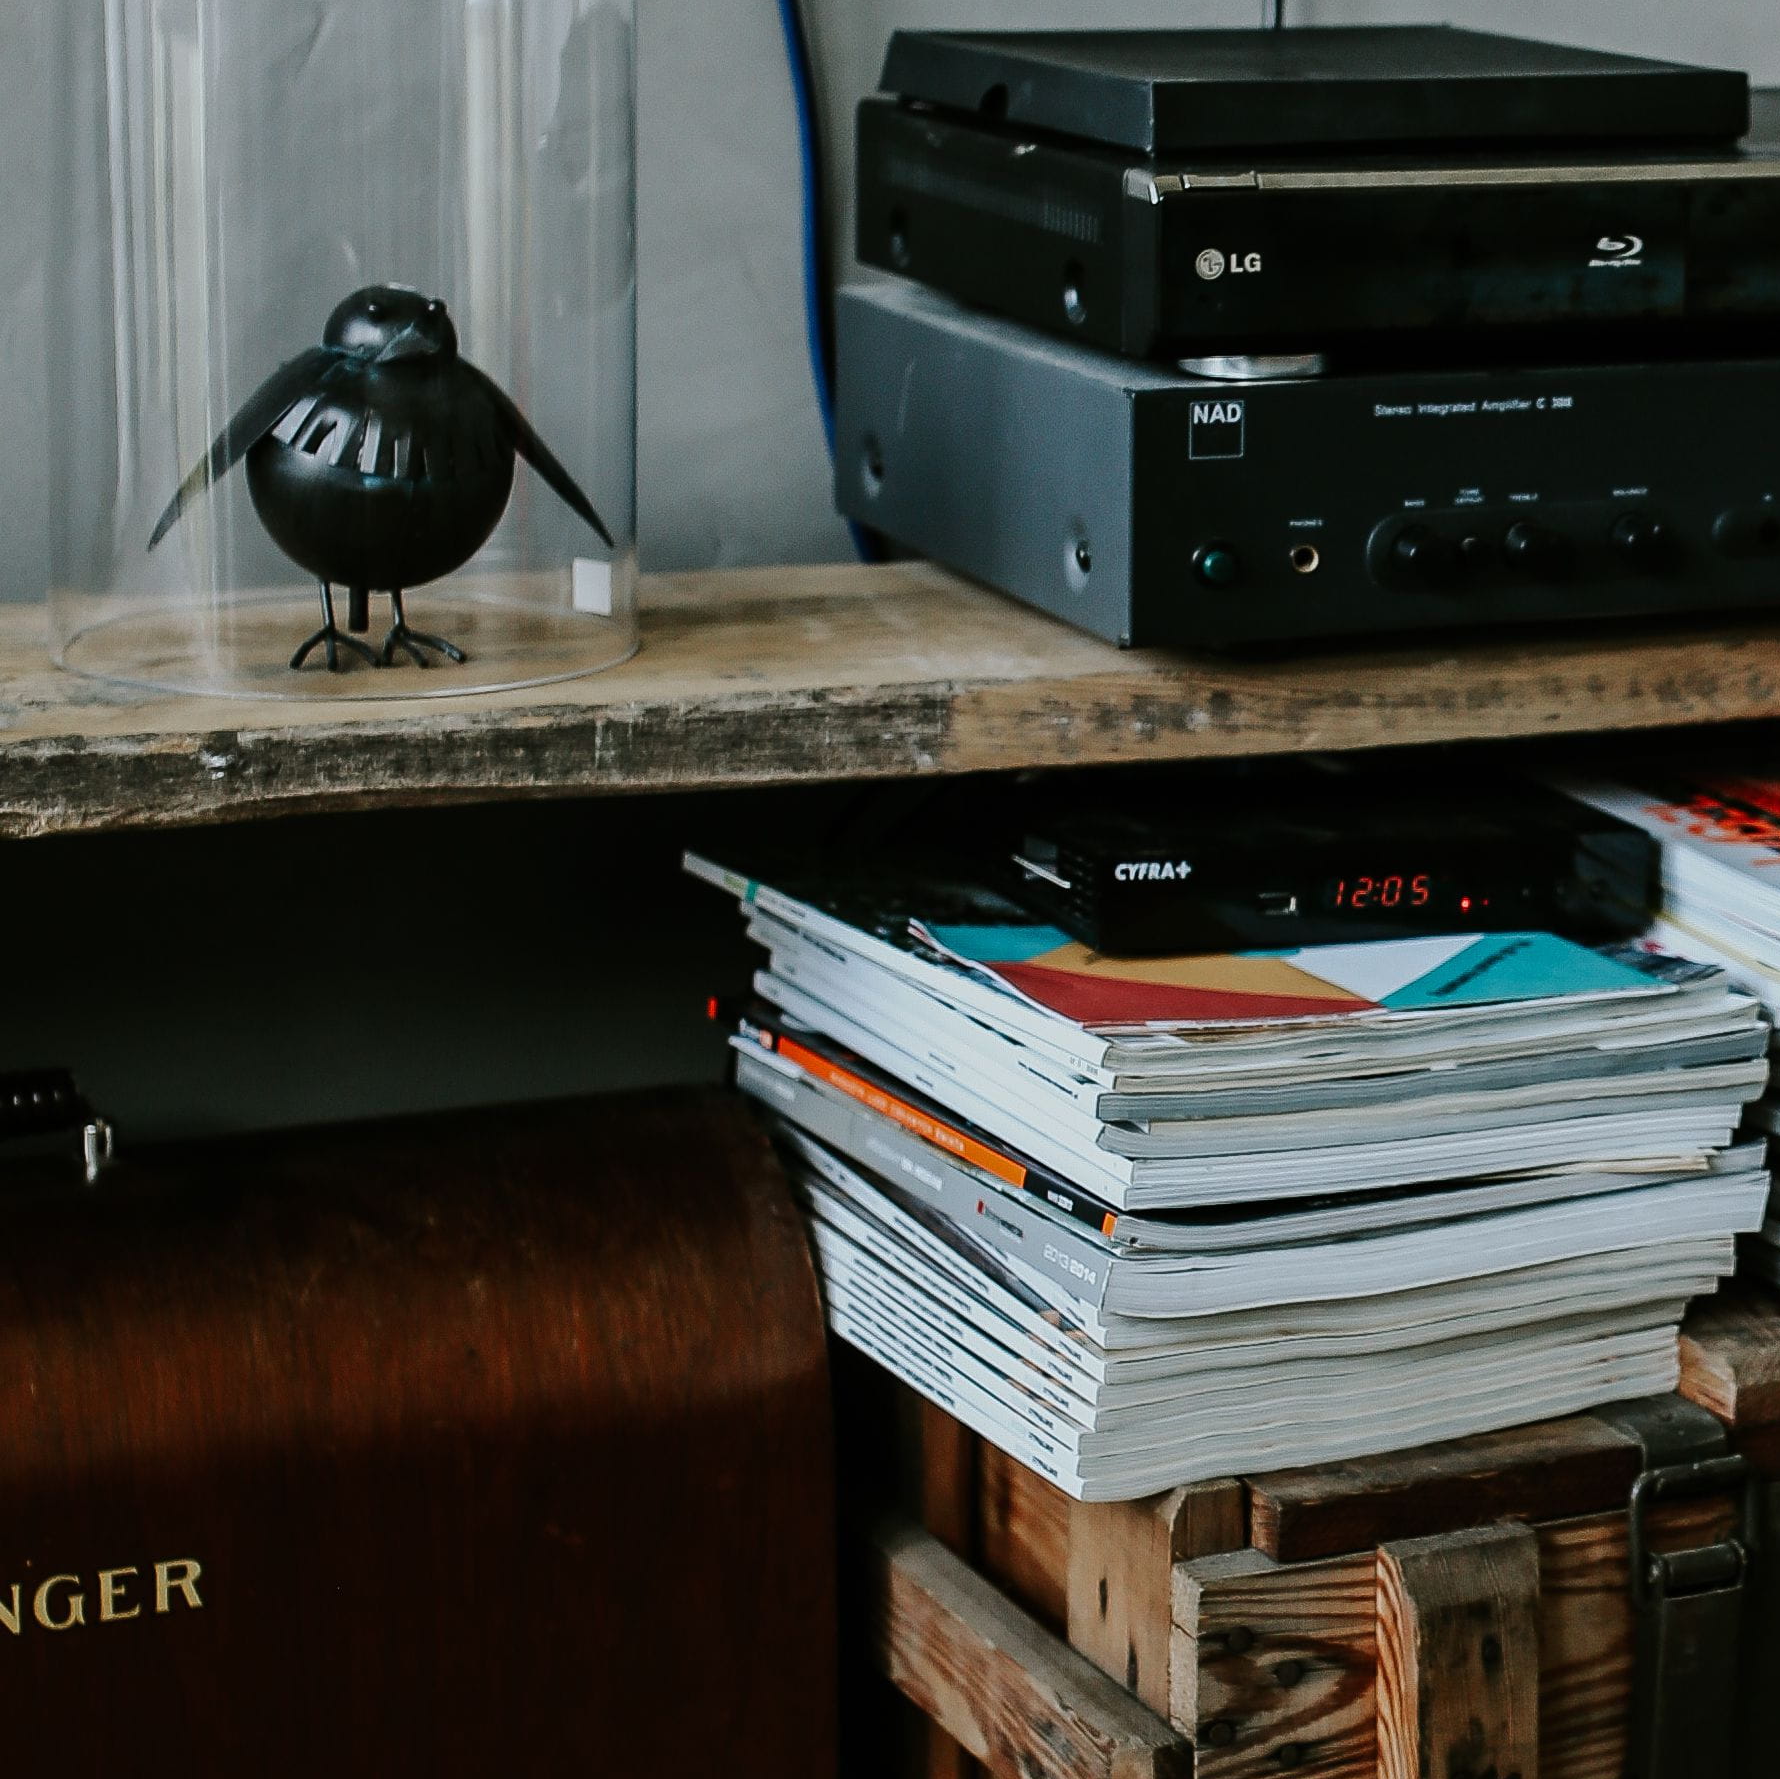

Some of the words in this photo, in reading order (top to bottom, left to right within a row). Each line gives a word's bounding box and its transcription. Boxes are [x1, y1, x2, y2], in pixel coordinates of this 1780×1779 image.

[1230, 253, 1261, 273] LG
[1193, 403, 1241, 424] NAD
[1114, 860, 1191, 881] CYFRA+
[1335, 875, 1429, 907] 12:05
